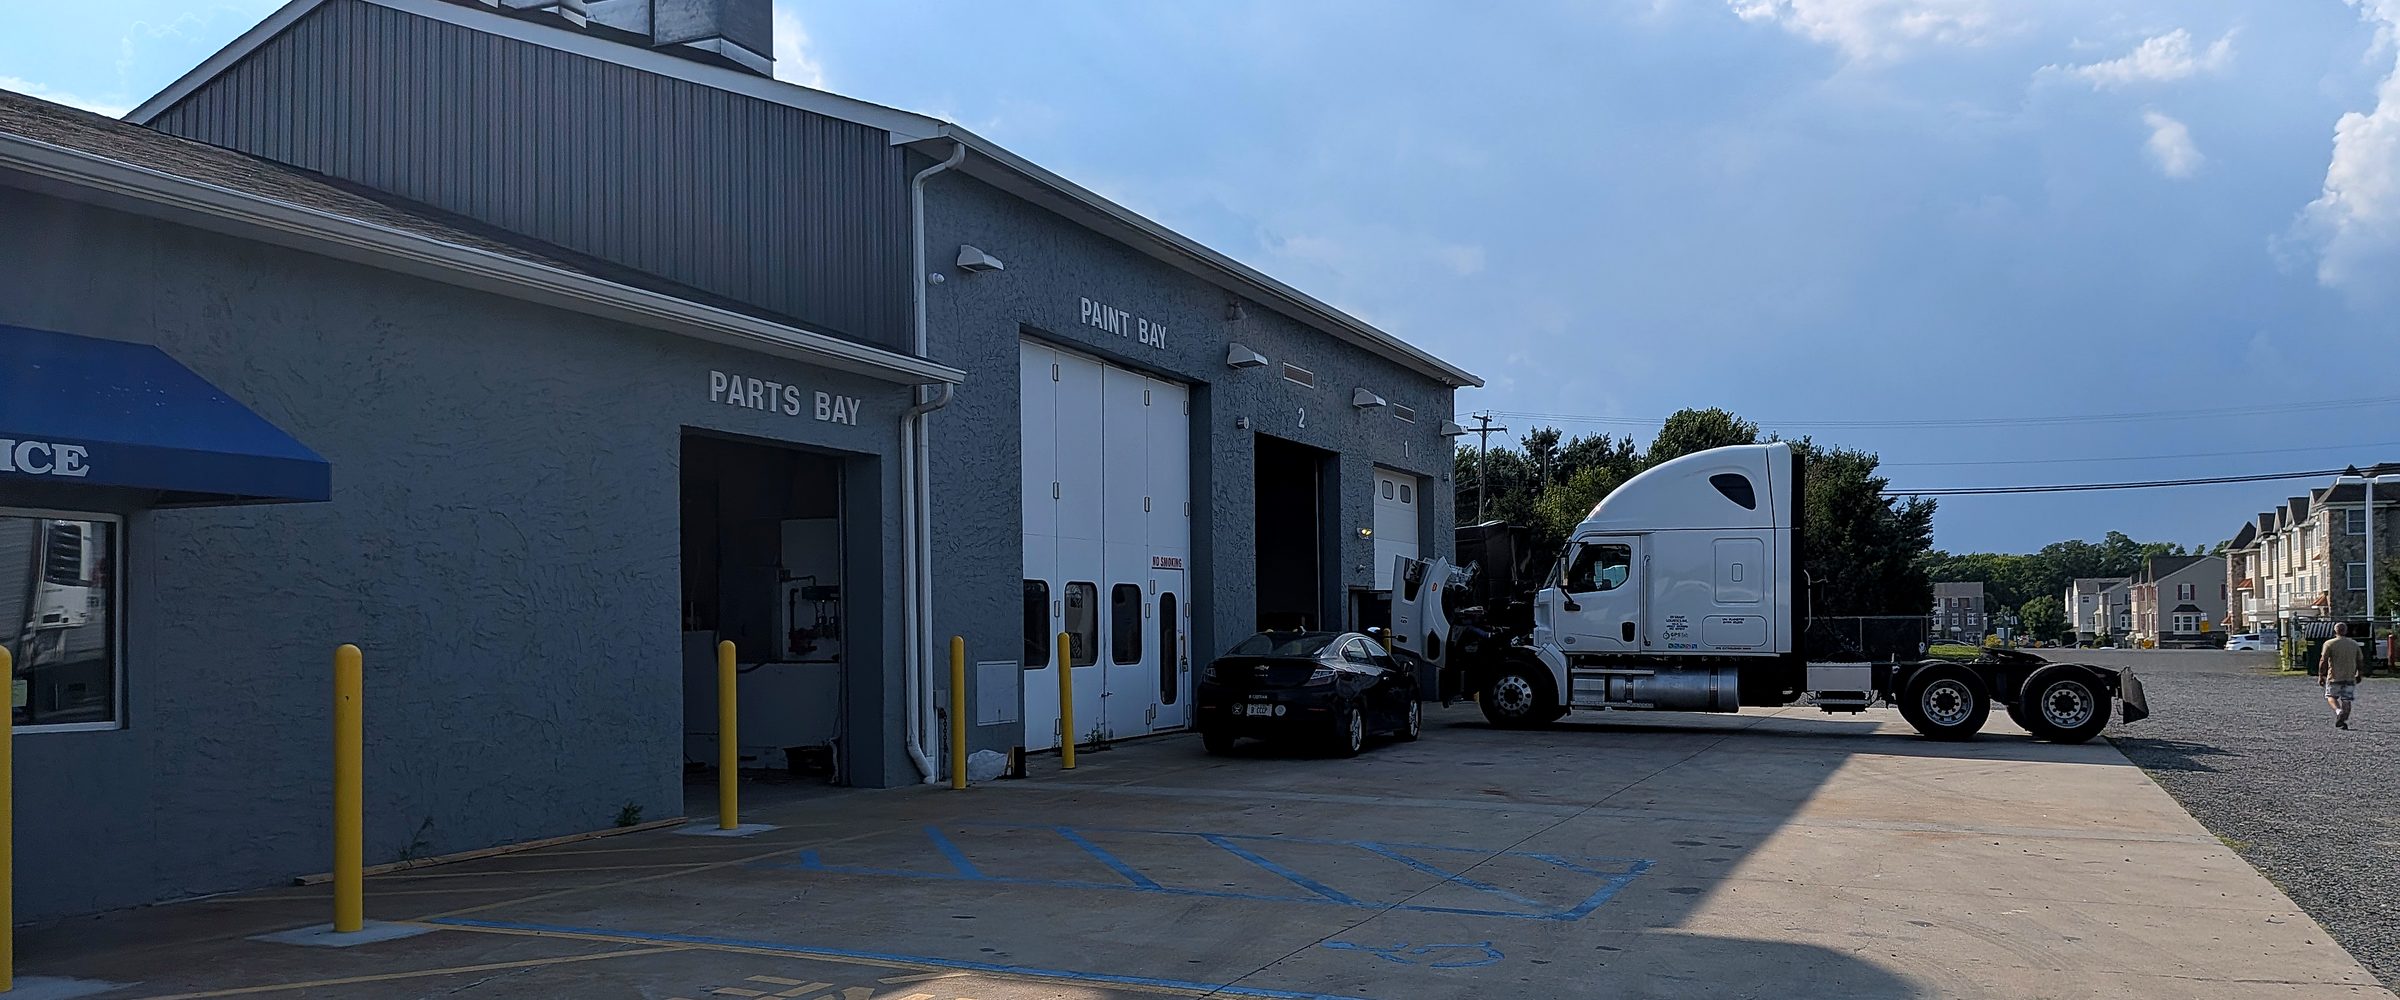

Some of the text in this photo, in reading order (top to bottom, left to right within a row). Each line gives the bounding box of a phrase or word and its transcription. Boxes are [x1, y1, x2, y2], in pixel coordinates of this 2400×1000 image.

[1081, 296, 1167, 350] PAINT BAY
[709, 370, 861, 426] PARTS BAY
[1298, 407, 1305, 429] 2
[0, 438, 90, 477] ICE
[1404, 440, 1409, 458] 1
[1152, 555, 1182, 568] NO SMOKING
